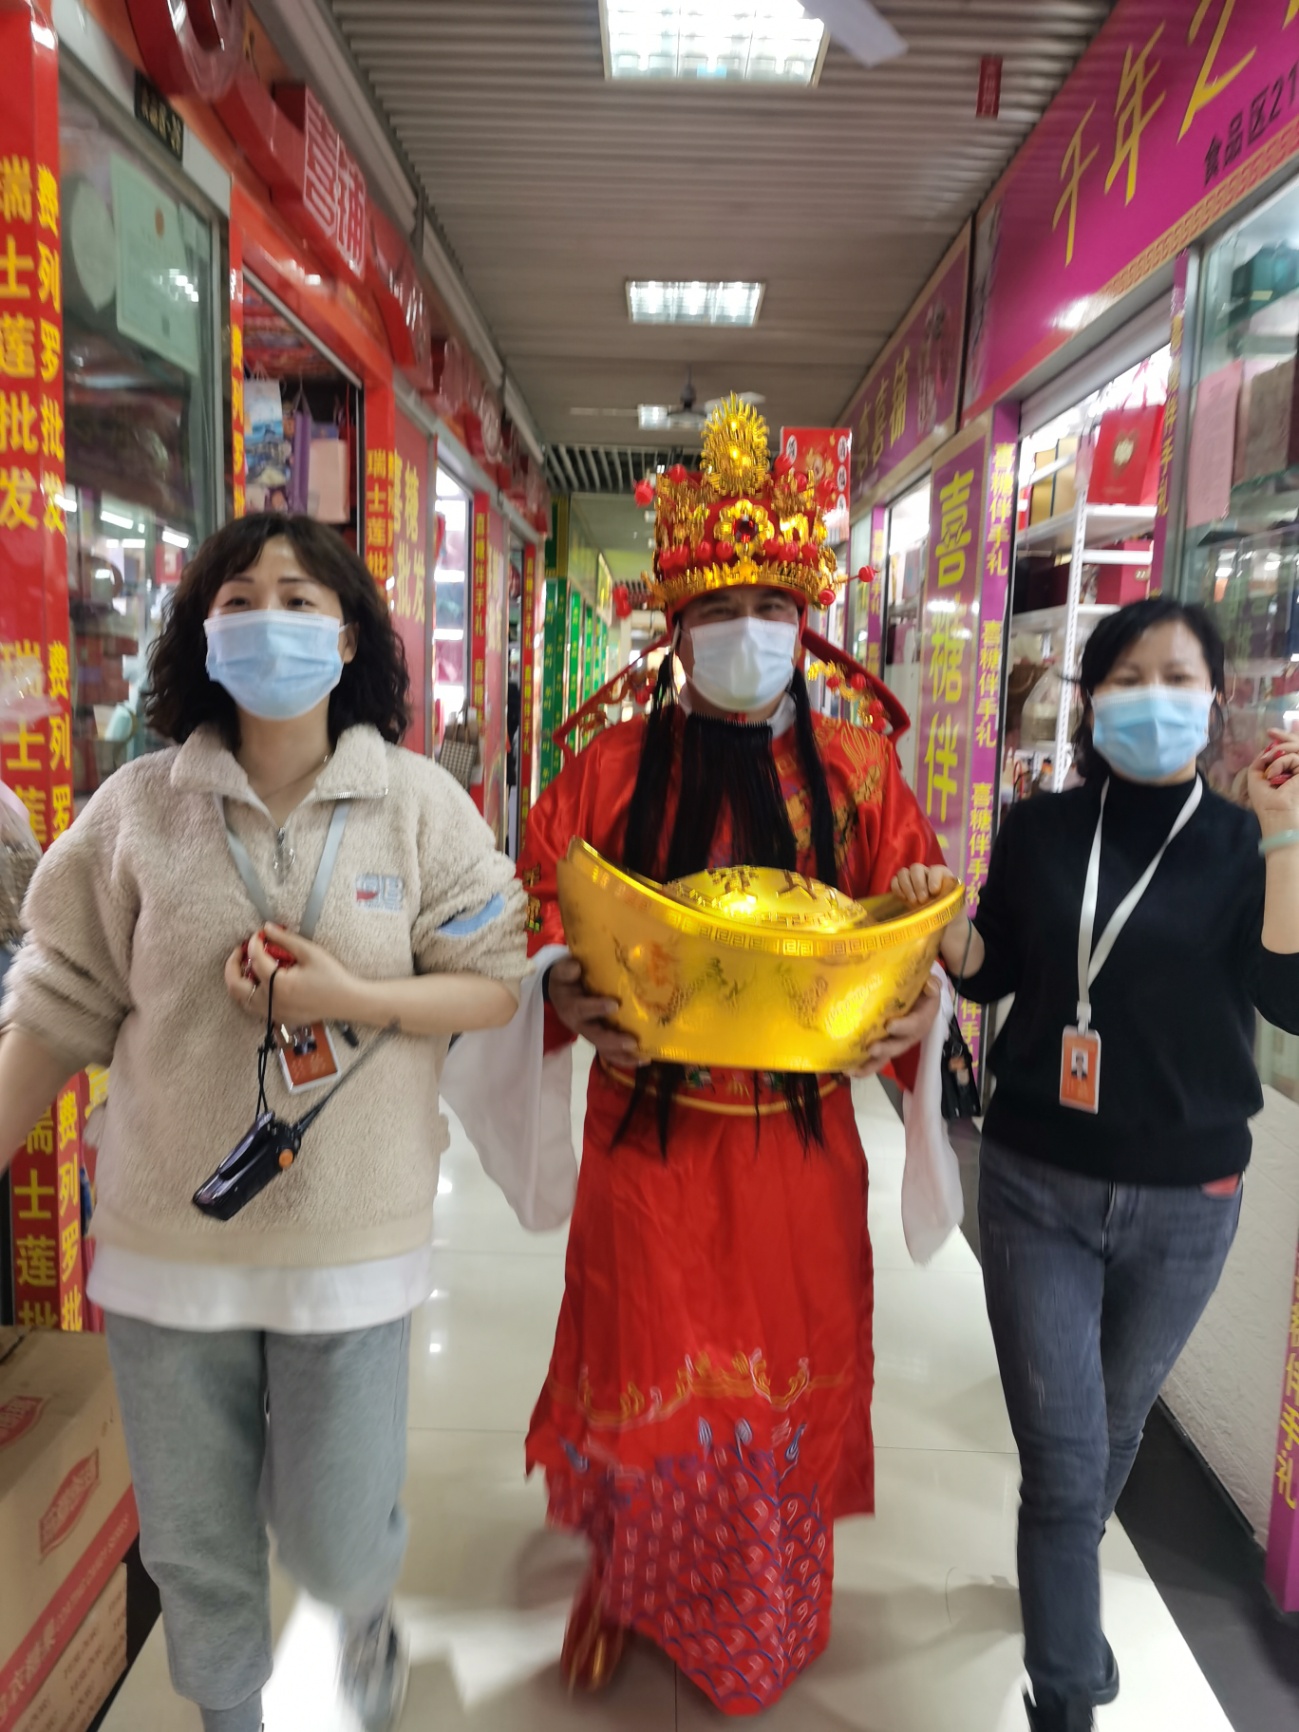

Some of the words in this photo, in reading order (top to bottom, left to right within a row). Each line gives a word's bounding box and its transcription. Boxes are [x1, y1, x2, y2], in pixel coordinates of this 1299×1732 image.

[985, 441, 1015, 576] 喜糖伴手礼
[924, 470, 975, 849] 喜糖伴
[975, 619, 1002, 748] 喜糖伴手礼
